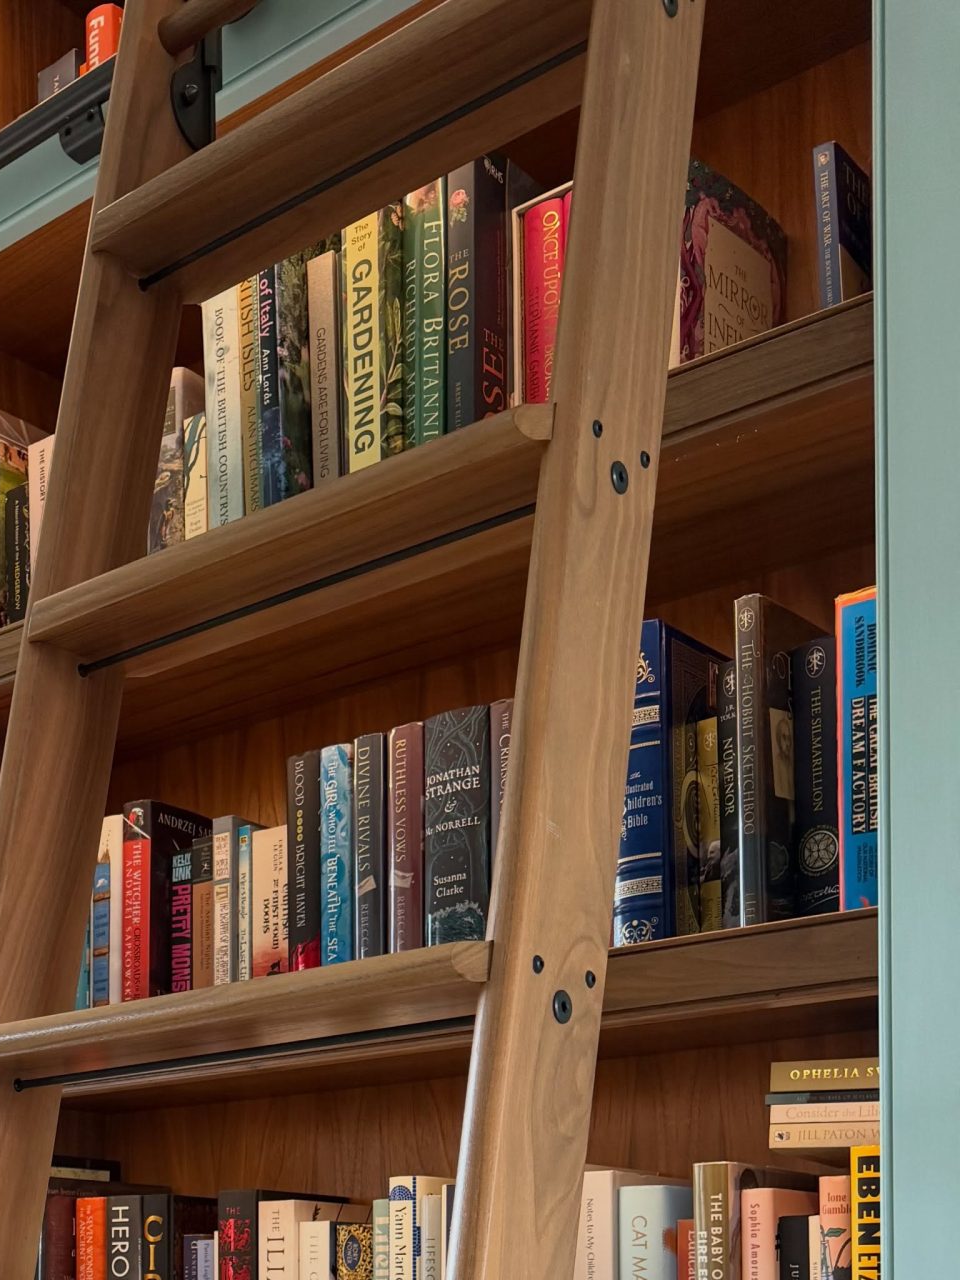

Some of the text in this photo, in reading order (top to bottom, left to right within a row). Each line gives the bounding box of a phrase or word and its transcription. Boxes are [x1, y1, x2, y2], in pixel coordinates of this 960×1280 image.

[448, 249, 470, 264] THE
[541, 211, 560, 319] ONCE UPON
[259, 278, 274, 338] of Italy
[447, 261, 469, 356] ROSE
[707, 263, 769, 328] MIRROR
[352, 259, 376, 456] GARDENING
[315, 328, 329, 479] GARDENS ARE FOR LIVING
[38, 449, 47, 503] THE HISTORY
[854, 616, 868, 688] SANDBROOK
[809, 686, 825, 813] THE SILMARILLION
[851, 697, 868, 834] DREAM FACTORY
[426, 764, 481, 788] JONATHAN
[426, 776, 481, 800] STRANGE
[722, 737, 739, 817] NÚMENOR
[357, 746, 372, 872] DIVINE RIVALS
[395, 739, 408, 863] RUTHLESS VOWS
[157, 811, 195, 836] ANDRZEJ
[627, 813, 649, 828] Bible
[172, 851, 192, 868] KELLY
[294, 760, 307, 928] BLOOD BRIGHT HAVEN
[171, 866, 192, 882] LINK
[433, 871, 468, 886] Susanna
[435, 885, 465, 899] Clarke
[789, 1066, 860, 1081] OPHELIA
[226, 1206, 241, 1216] THE
[586, 1198, 597, 1222] Notes
[710, 1192, 723, 1222] THE
[857, 1156, 881, 1245] EBEN
[85, 1215, 95, 1248] SEVEN
[271, 1209, 281, 1234] THE
[394, 1206, 408, 1241] Yann
[587, 1223, 597, 1234] to
[631, 1215, 648, 1249] CAT
[748, 1202, 761, 1239] Sophia
[78, 1219, 87, 1257] ANCIENT
[586, 1235, 598, 1251] My
[697, 1230, 710, 1264] FIRE
[711, 1226, 724, 1264] BABY
